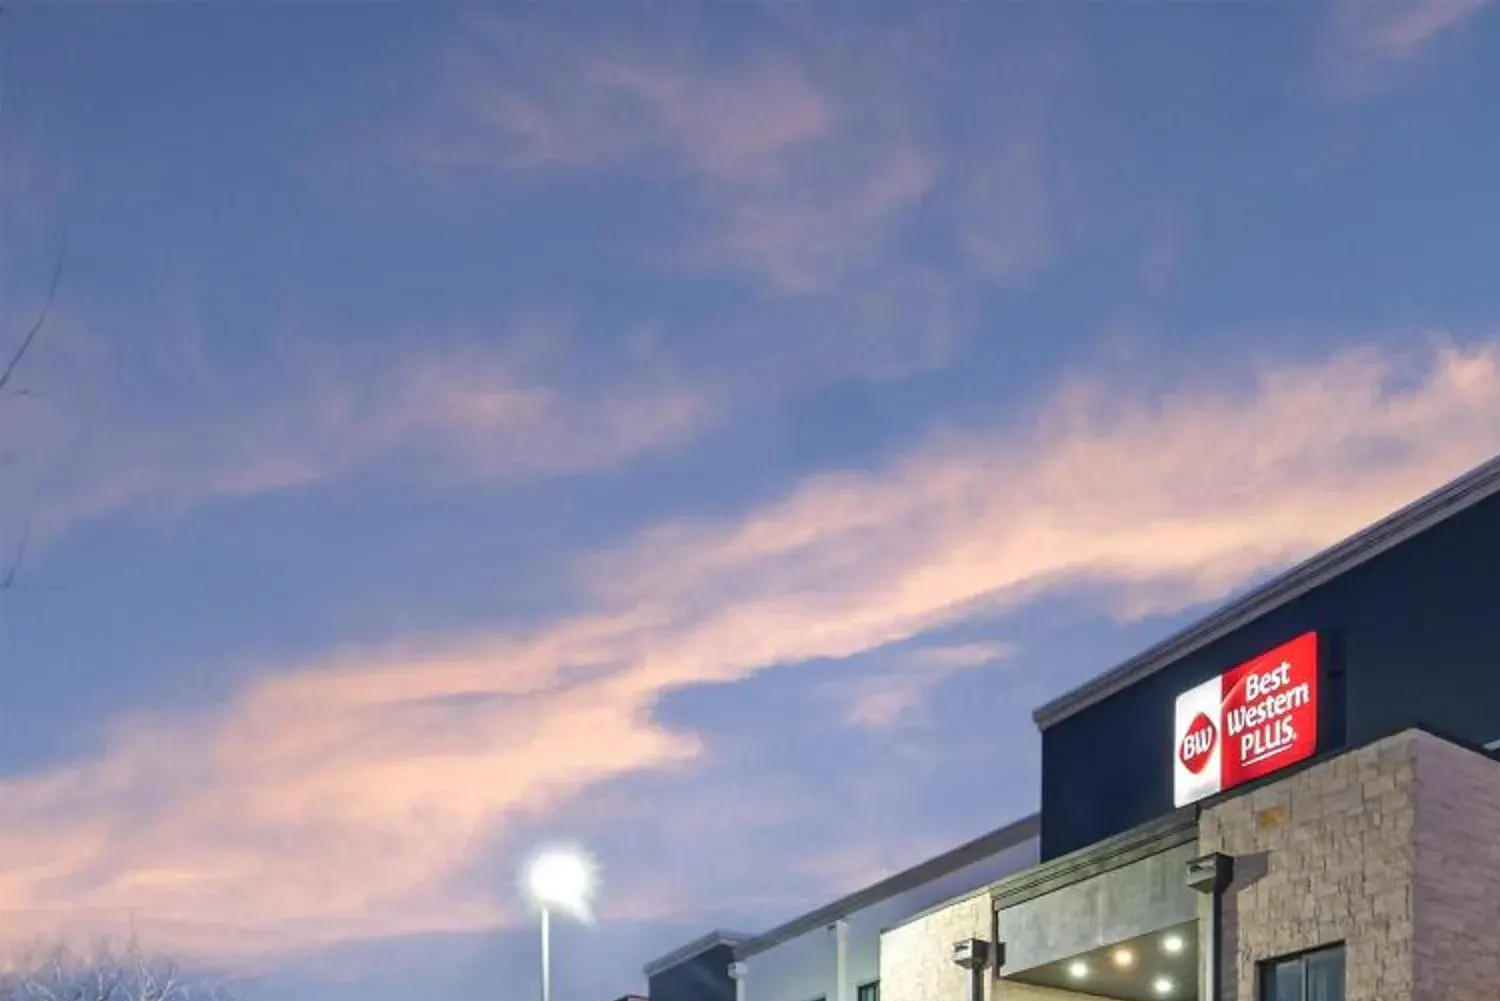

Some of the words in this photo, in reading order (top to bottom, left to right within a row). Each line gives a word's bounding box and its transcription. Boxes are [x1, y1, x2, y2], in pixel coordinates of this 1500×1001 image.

[1246, 662, 1291, 702] Best
[1227, 683, 1309, 736] Western
[1184, 727, 1213, 760] BW
[1241, 715, 1294, 761] PLUS
